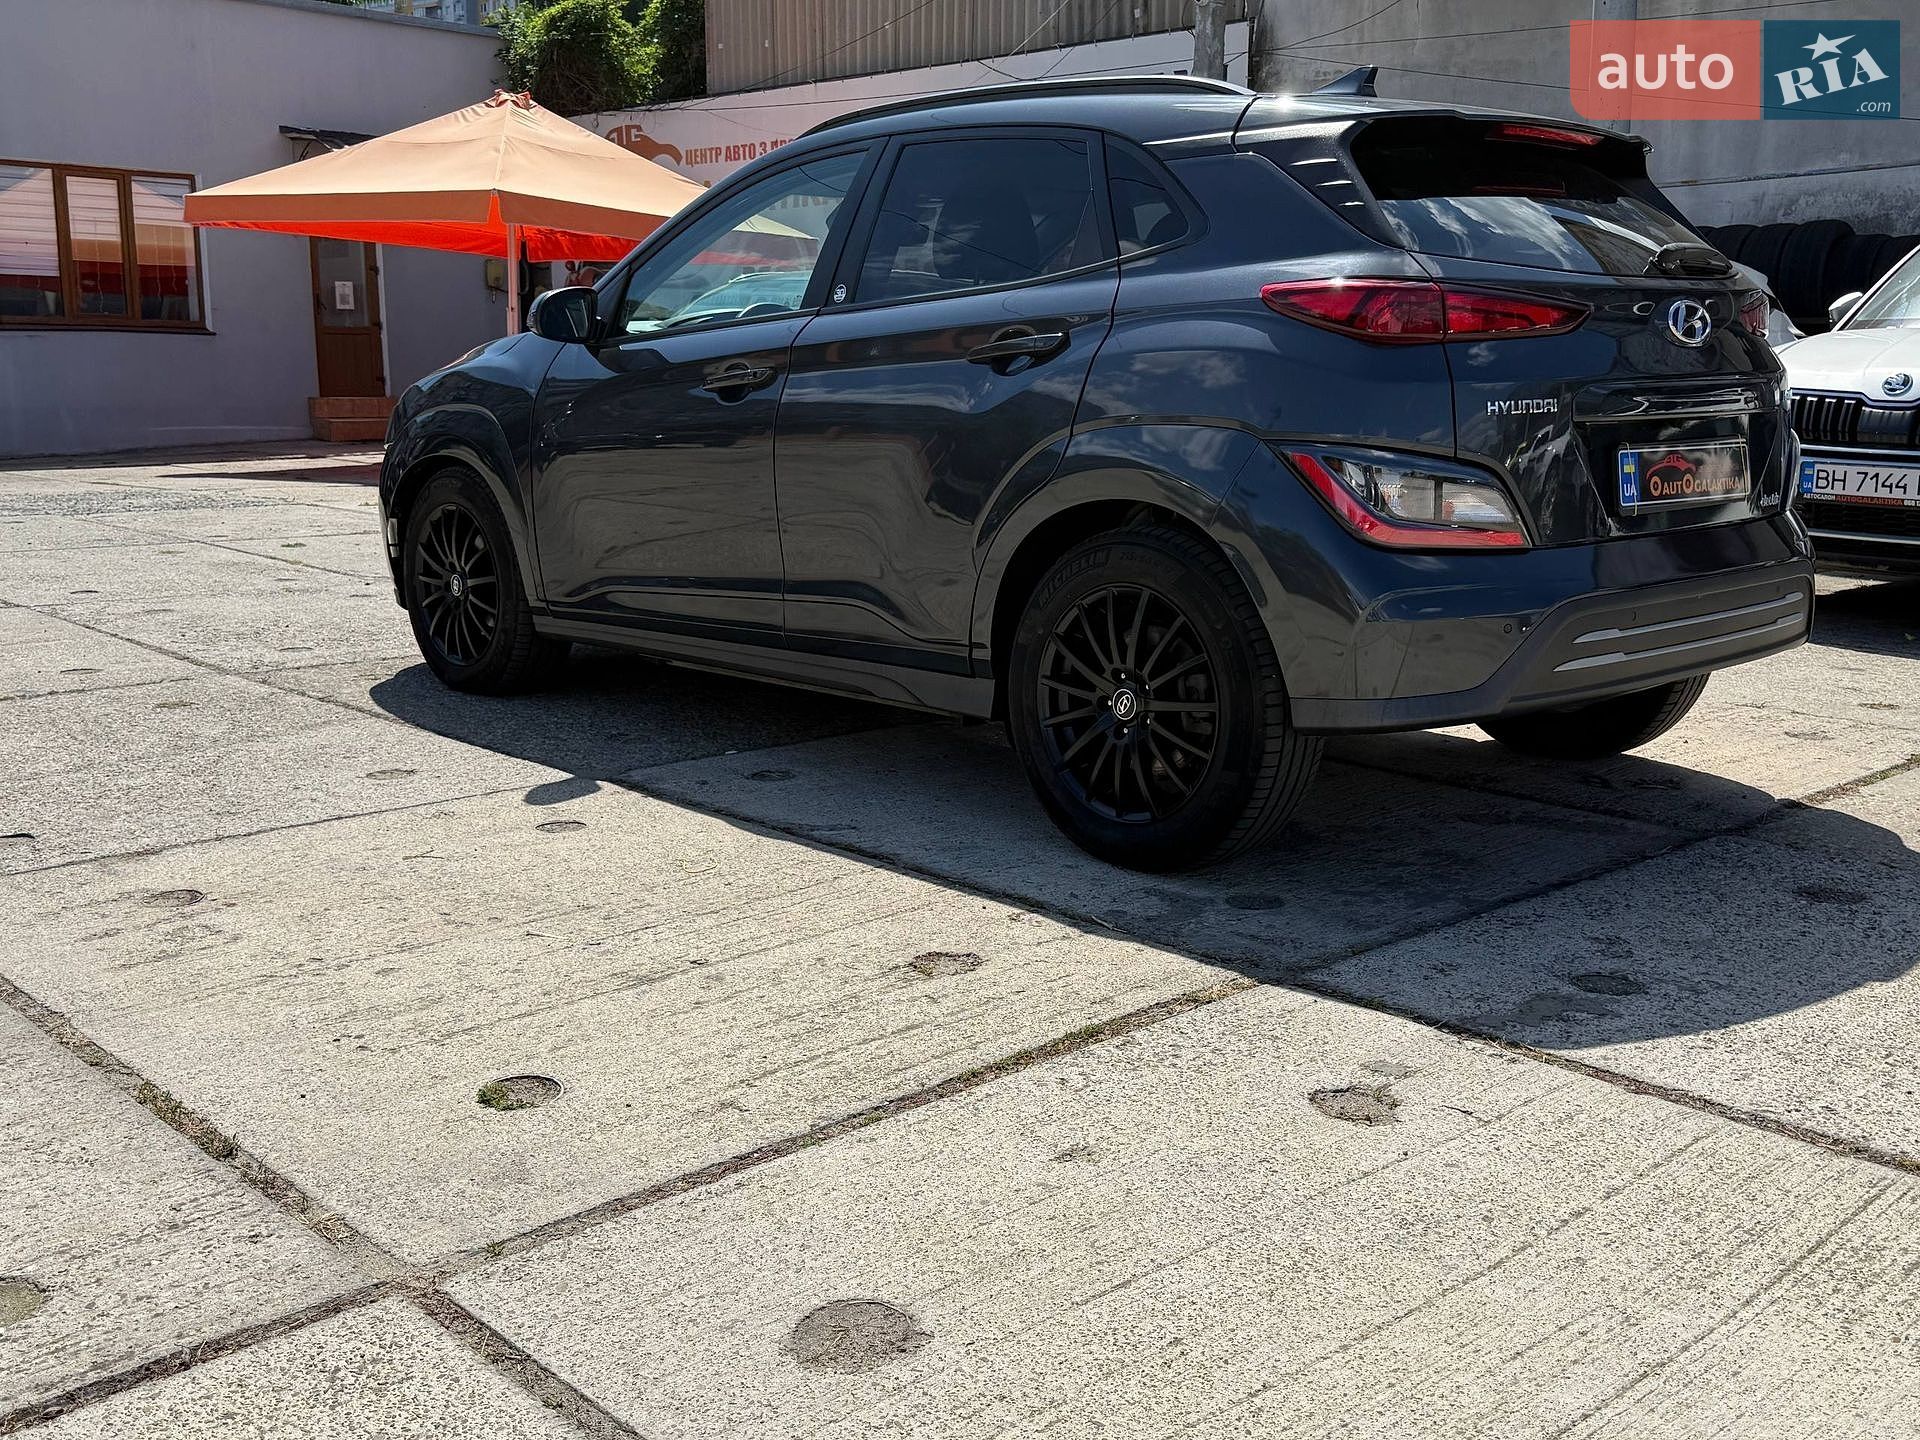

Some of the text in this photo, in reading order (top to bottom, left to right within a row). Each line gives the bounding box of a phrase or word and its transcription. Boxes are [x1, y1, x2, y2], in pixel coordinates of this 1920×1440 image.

[685, 147, 722, 167] ЦЕНТР
[725, 141, 755, 163] АВТО
[1487, 398, 1557, 416] HYUNDAI
[1623, 483, 1637, 498] UA
[1803, 481, 1812, 489] UA
[1815, 469, 1908, 495] BH 7144
